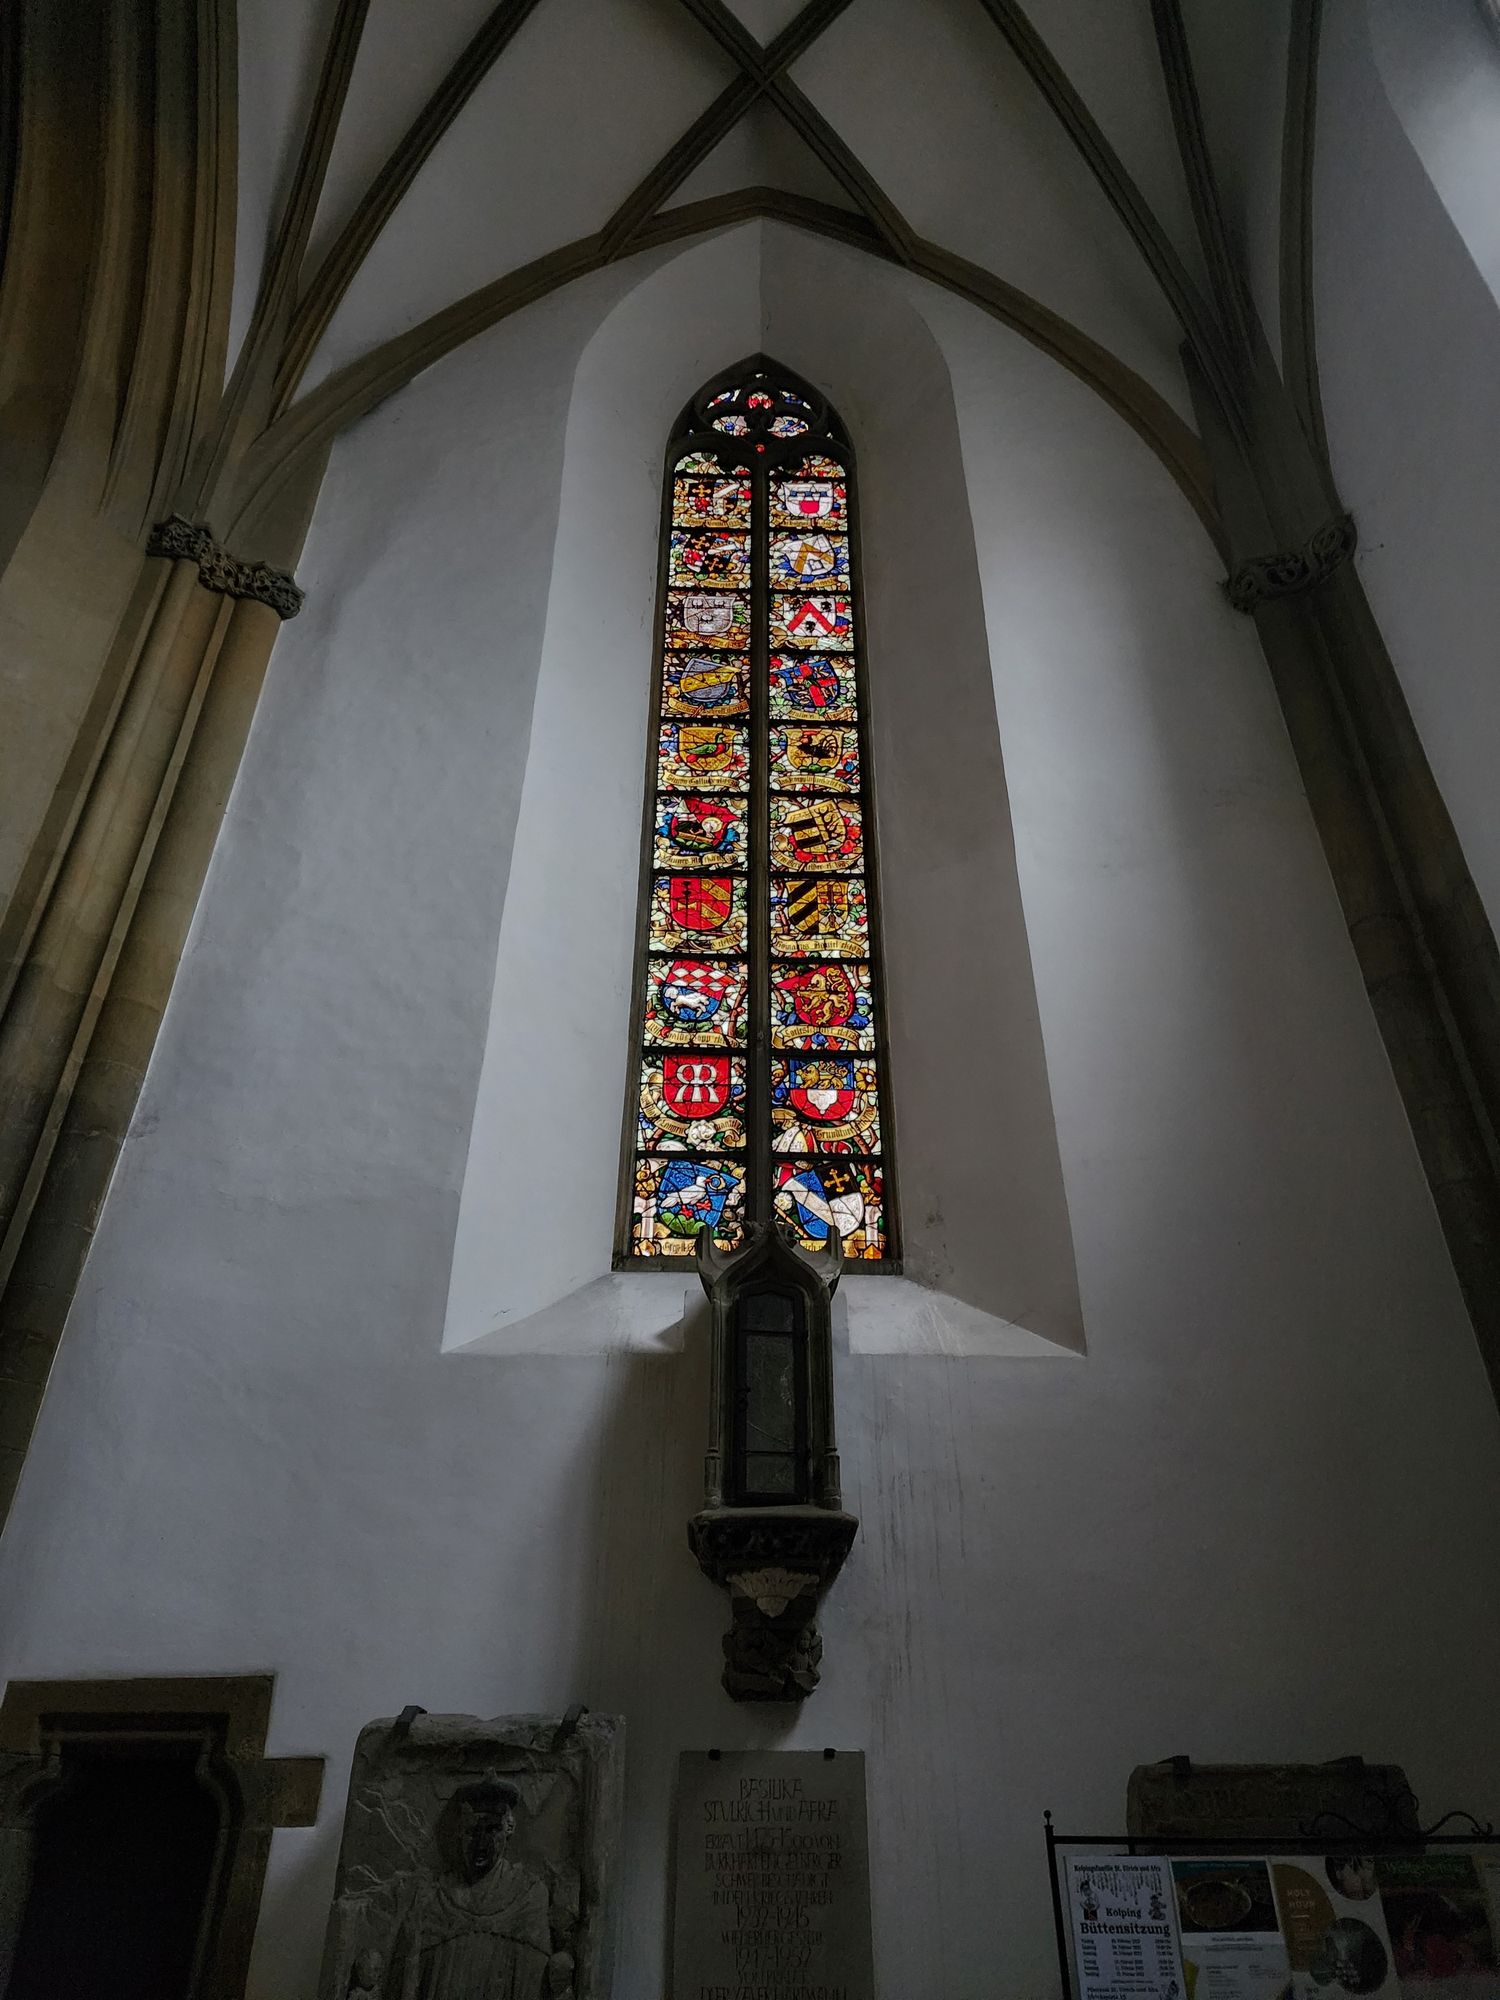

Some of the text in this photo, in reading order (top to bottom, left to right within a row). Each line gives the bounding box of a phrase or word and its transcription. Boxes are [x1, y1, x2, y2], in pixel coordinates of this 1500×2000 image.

[739, 1778, 803, 1801] BASILIKA
[797, 1799, 838, 1822] AFRA
[736, 1905, 810, 1929] 1939-1945
[1105, 1907, 1142, 1920] Kolping
[1080, 1922, 1171, 1938] Büttensitzung
